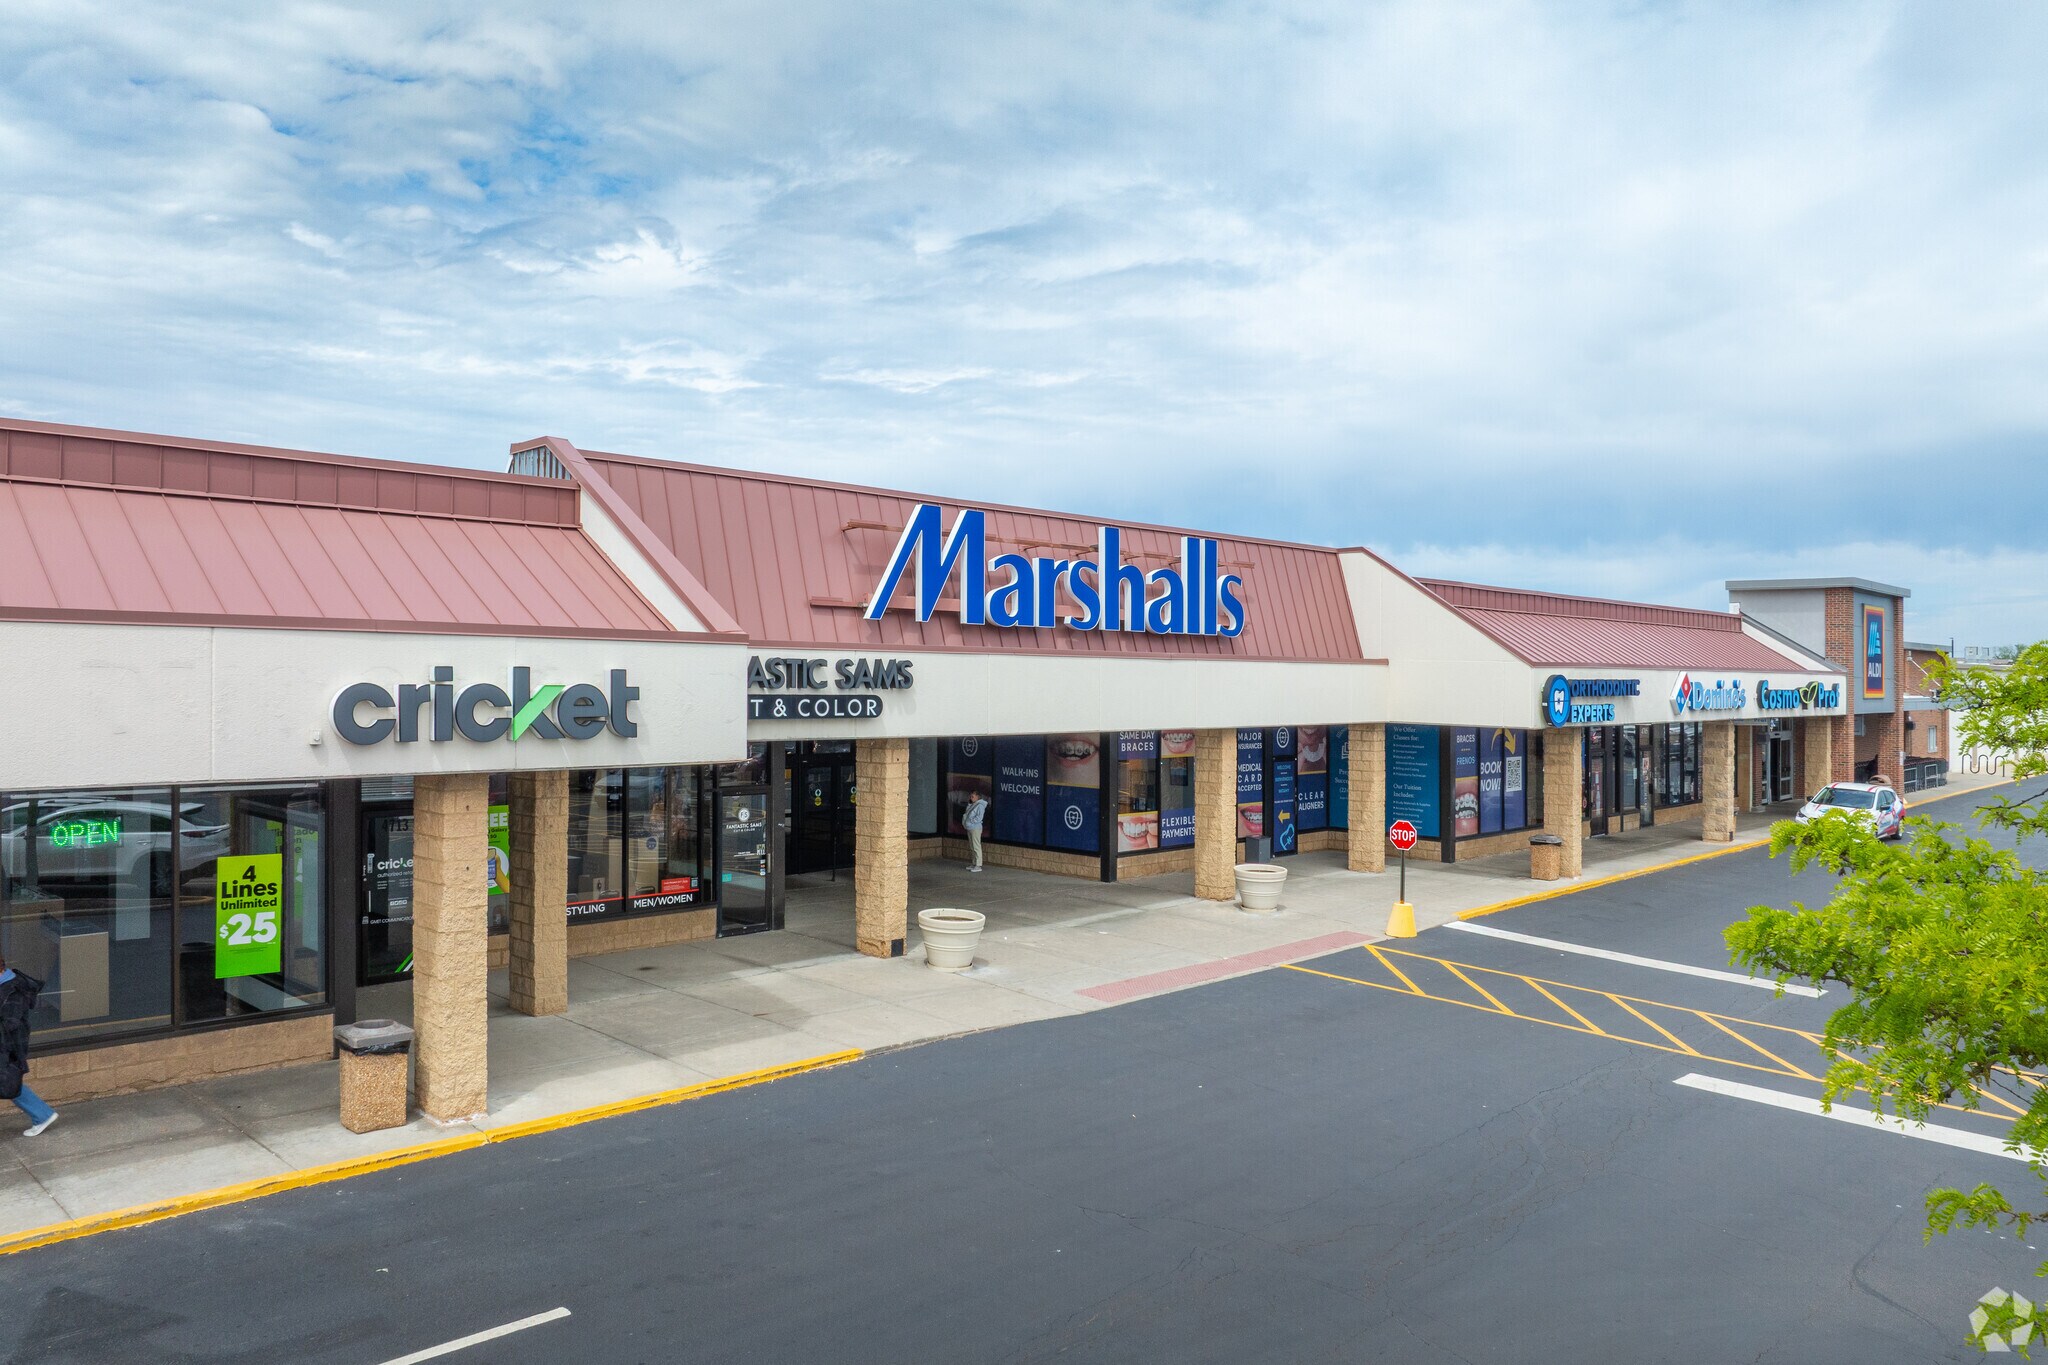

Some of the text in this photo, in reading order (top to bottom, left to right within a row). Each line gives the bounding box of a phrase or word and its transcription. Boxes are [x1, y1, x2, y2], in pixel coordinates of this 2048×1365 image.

[863, 503, 1245, 638] Marshalls
[748, 655, 914, 690] ASTIC SAMS
[1868, 662, 1882, 678] ALDI
[1570, 679, 1640, 697] ORTHODONTIC
[1757, 679, 1841, 710] Cosmo Prof
[1689, 679, 1747, 711] Domino's
[330, 666, 640, 746] cricket
[750, 698, 878, 717] T & COLOR
[1570, 704, 1616, 723] EXPERTS
[1119, 730, 1156, 741] SAME DAY
[1238, 733, 1262, 741] MAJOR
[1457, 735, 1475, 743] BRACES
[1121, 742, 1155, 752] BRACES
[1238, 763, 1262, 772] MEDICAL
[1457, 757, 1475, 765] FRENOS
[1481, 761, 1502, 774] BOOK
[1002, 767, 1039, 778] WALK-INS
[1238, 773, 1262, 783] CARD
[1000, 783, 1041, 795] WELCOME
[1481, 778, 1502, 791] NOW!
[1298, 791, 1325, 801] CLEAR
[1298, 801, 1325, 812] ALIGNERS
[382, 818, 409, 832] 4713
[490, 812, 508, 827] EE
[1161, 816, 1196, 828] FLEXIBLE
[52, 820, 119, 848] OPEN
[1161, 827, 1196, 839] PAYMENTS
[1391, 829, 1415, 842] STOP
[242, 865, 257, 883] 4
[221, 880, 278, 899] Lines
[220, 897, 278, 911] Unlimited
[633, 893, 693, 909] MEN/WOMEN
[565, 903, 606, 916] STYLING
[219, 911, 278, 946] $25
